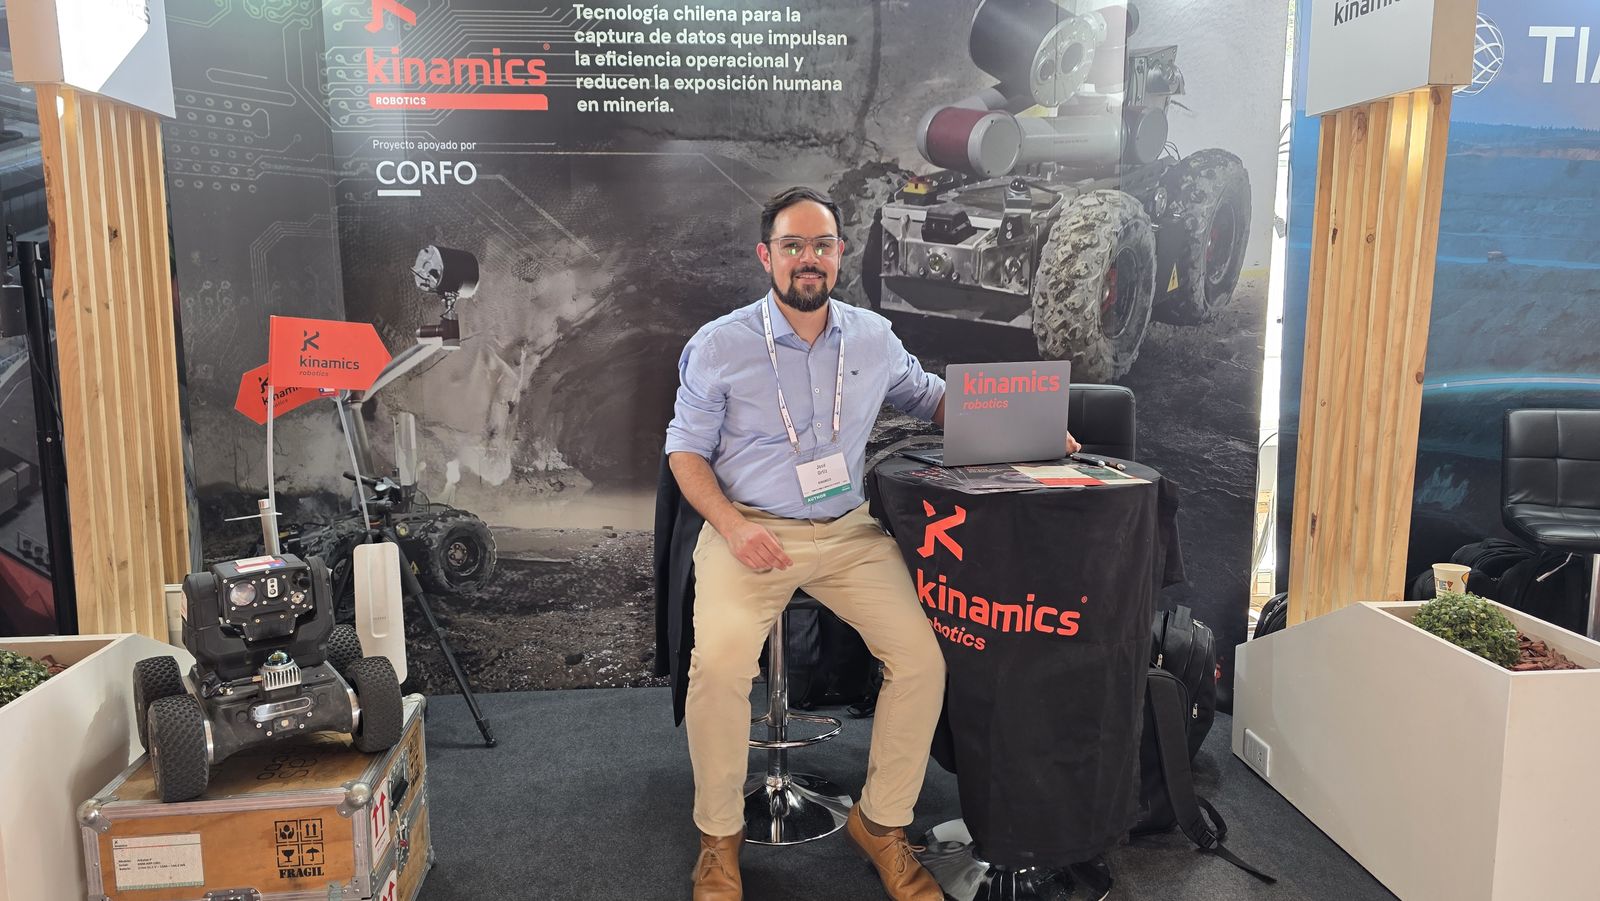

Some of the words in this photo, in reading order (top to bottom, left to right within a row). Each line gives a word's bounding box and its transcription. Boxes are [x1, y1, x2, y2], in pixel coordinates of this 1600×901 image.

[573, 4, 669, 24] Tecnología
[673, 5, 737, 22] chilena
[742, 9, 782, 25] para
[786, 7, 801, 22] la
[1334, 0, 1400, 26] kinam
[574, 30, 644, 47] captura
[649, 29, 671, 44] de
[676, 29, 726, 45] datos
[730, 32, 763, 48] que
[768, 30, 848, 49] impulsan
[365, 47, 548, 86] kinamics
[575, 51, 590, 66] la
[595, 51, 681, 67] eficiencia
[686, 52, 788, 71] operacional
[794, 57, 804, 71] y
[576, 74, 650, 90] reducen
[654, 74, 670, 90] la
[674, 76, 768, 93] exposición
[773, 77, 842, 91] humana
[375, 96, 427, 106] ROBOTICS
[577, 100, 598, 112] en
[603, 97, 674, 112] minería.
[373, 140, 414, 151] Proyecto
[418, 140, 457, 151] apoyado
[461, 142, 476, 151] por
[376, 161, 477, 184] CORFO
[300, 355, 359, 370] kinamics
[963, 370, 1060, 395] kinamics
[962, 399, 1009, 410] robotics
[808, 494, 826, 502] AUTHOR
[917, 568, 1080, 636] kinamics
[927, 617, 986, 650] botics
[279, 868, 324, 878] FRAGIL
